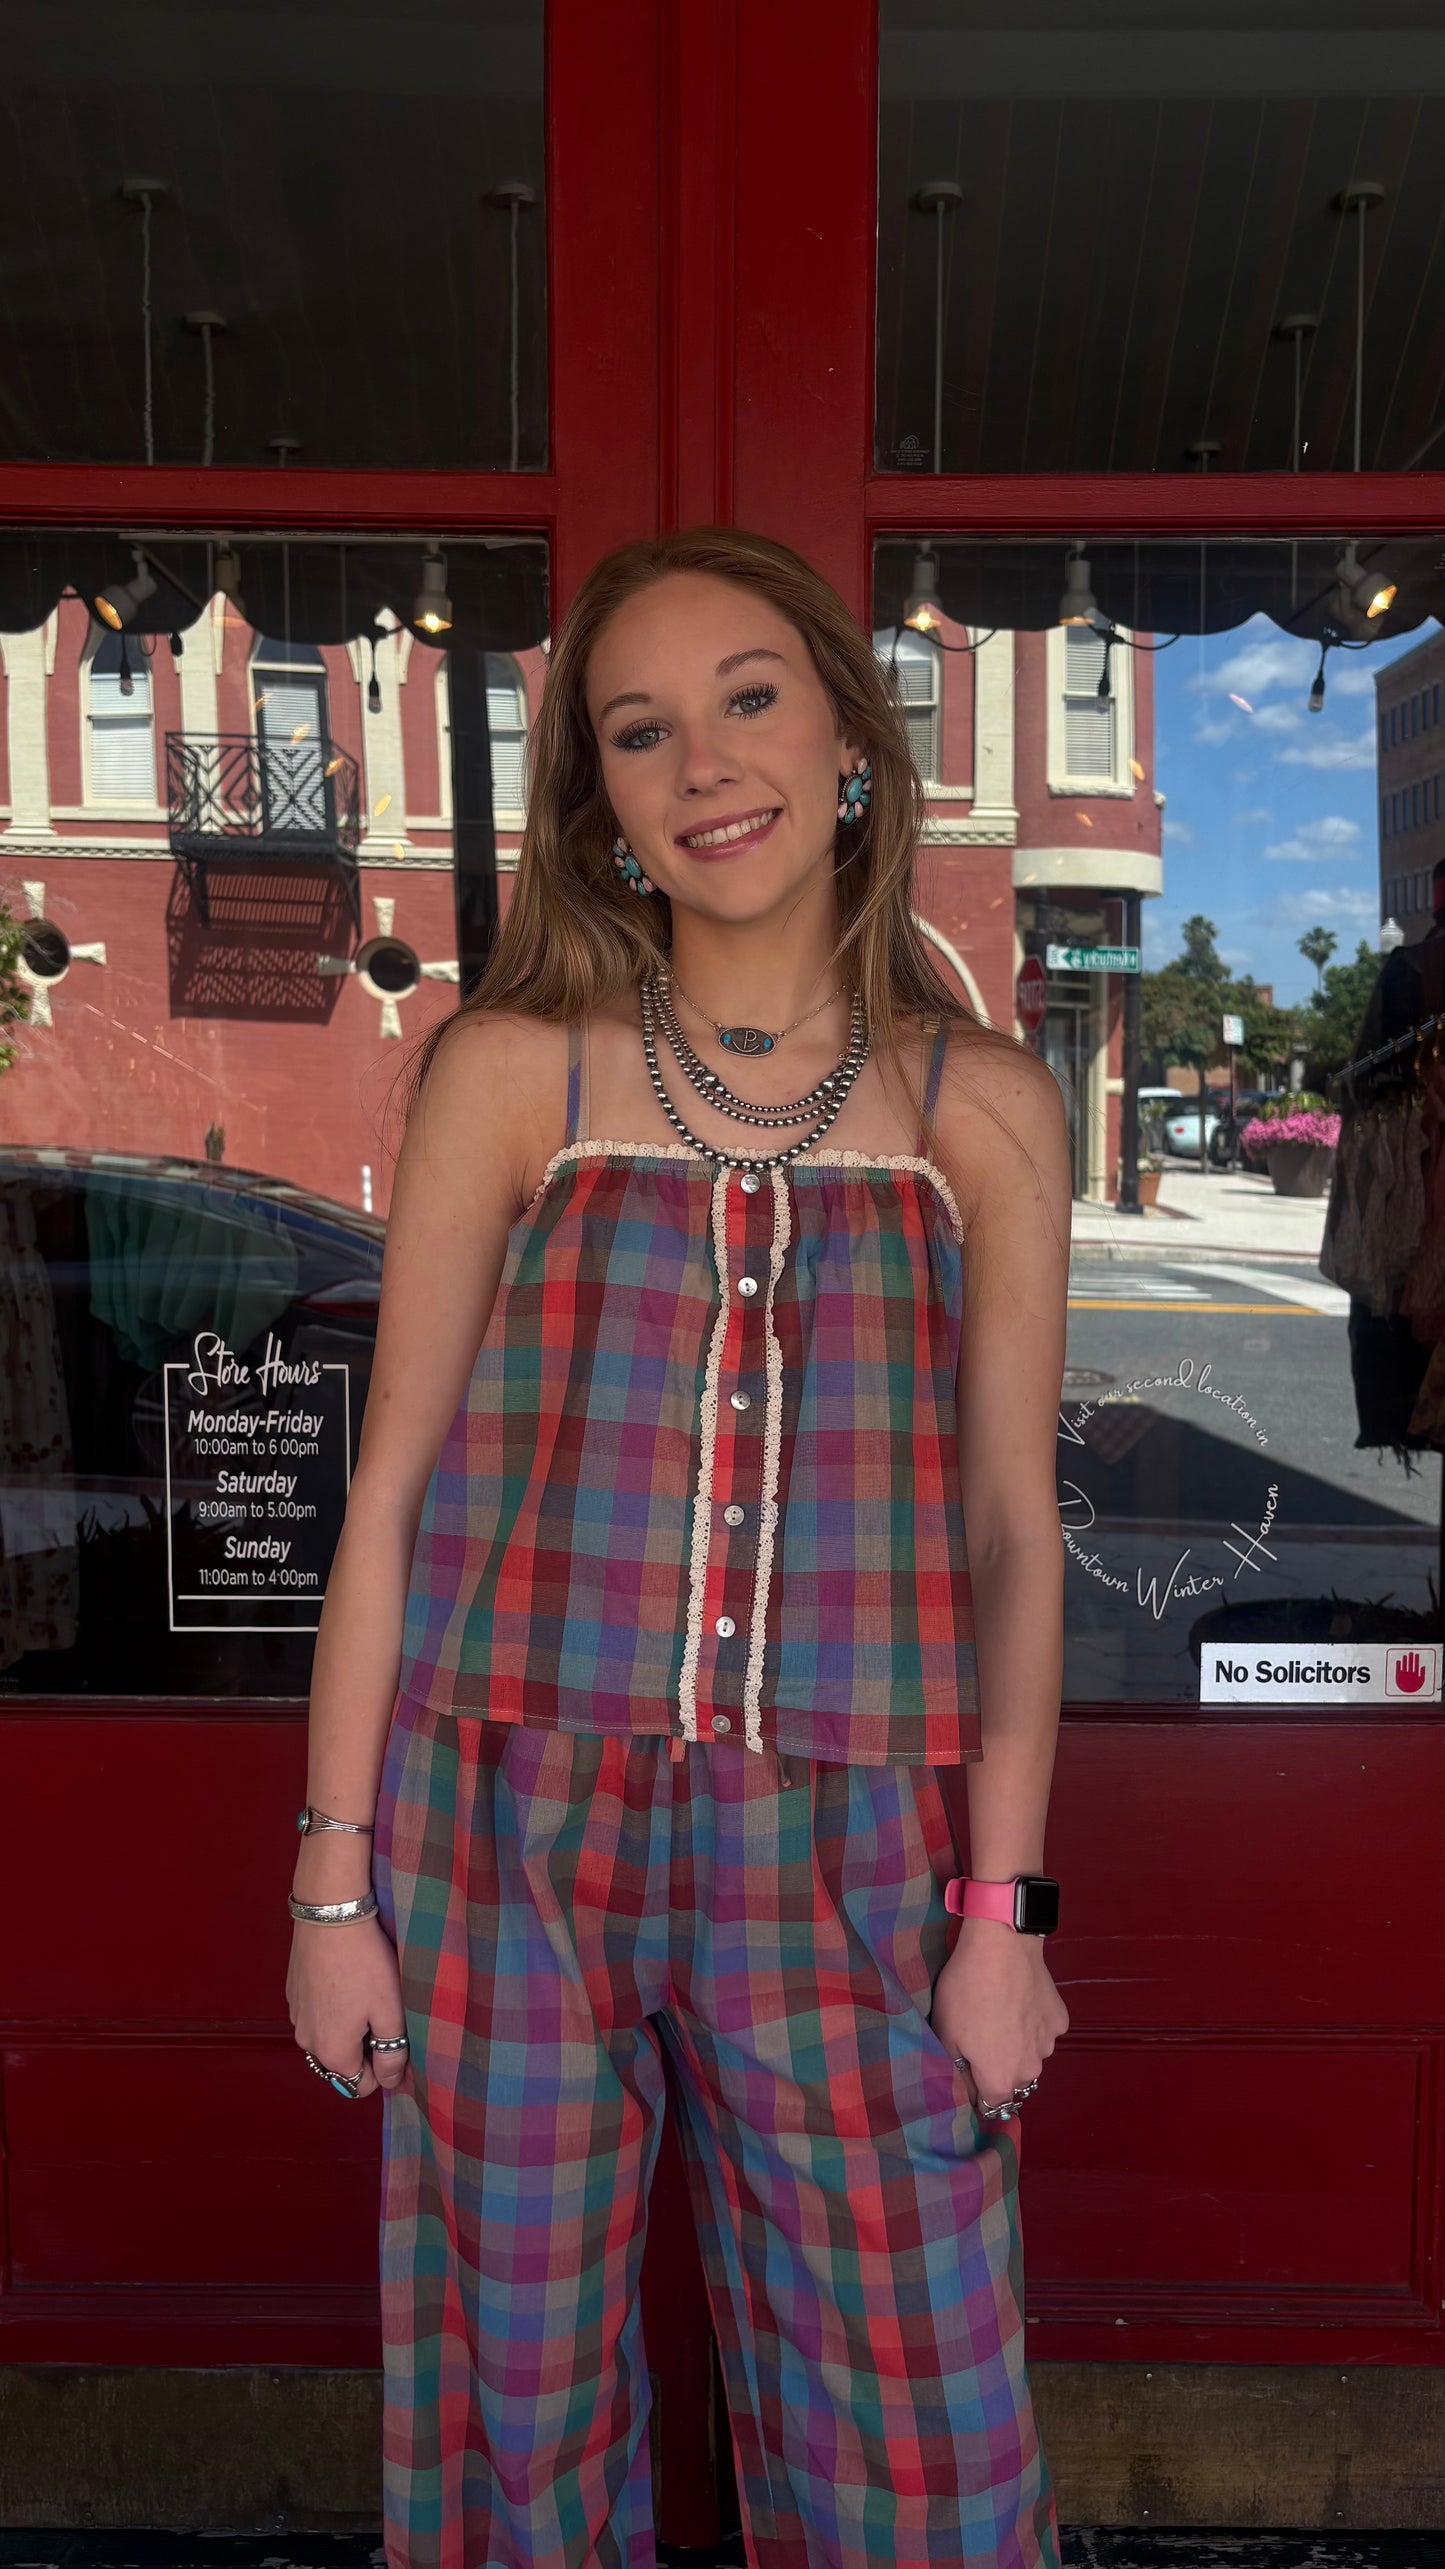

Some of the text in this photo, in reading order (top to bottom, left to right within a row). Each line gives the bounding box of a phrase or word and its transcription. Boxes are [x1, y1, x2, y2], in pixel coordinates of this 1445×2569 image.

[187, 1331, 321, 1397] Store Hours
[1057, 1358, 1269, 1447] Visit our second location in
[187, 1409, 324, 1438] Monday-Friday
[194, 1438, 249, 1455] 10:00am
[252, 1439, 266, 1455] to
[216, 1470, 298, 1498] Saturday
[199, 1501, 247, 1518] 9:00am
[250, 1502, 264, 1518] to
[224, 1535, 292, 1563] Sunday
[1058, 1480, 1280, 1620] Downtown Winter Haven
[198, 1568, 249, 1586] 11:00am
[251, 1569, 265, 1586] to
[1215, 1660, 1371, 1684] No Solicitors
